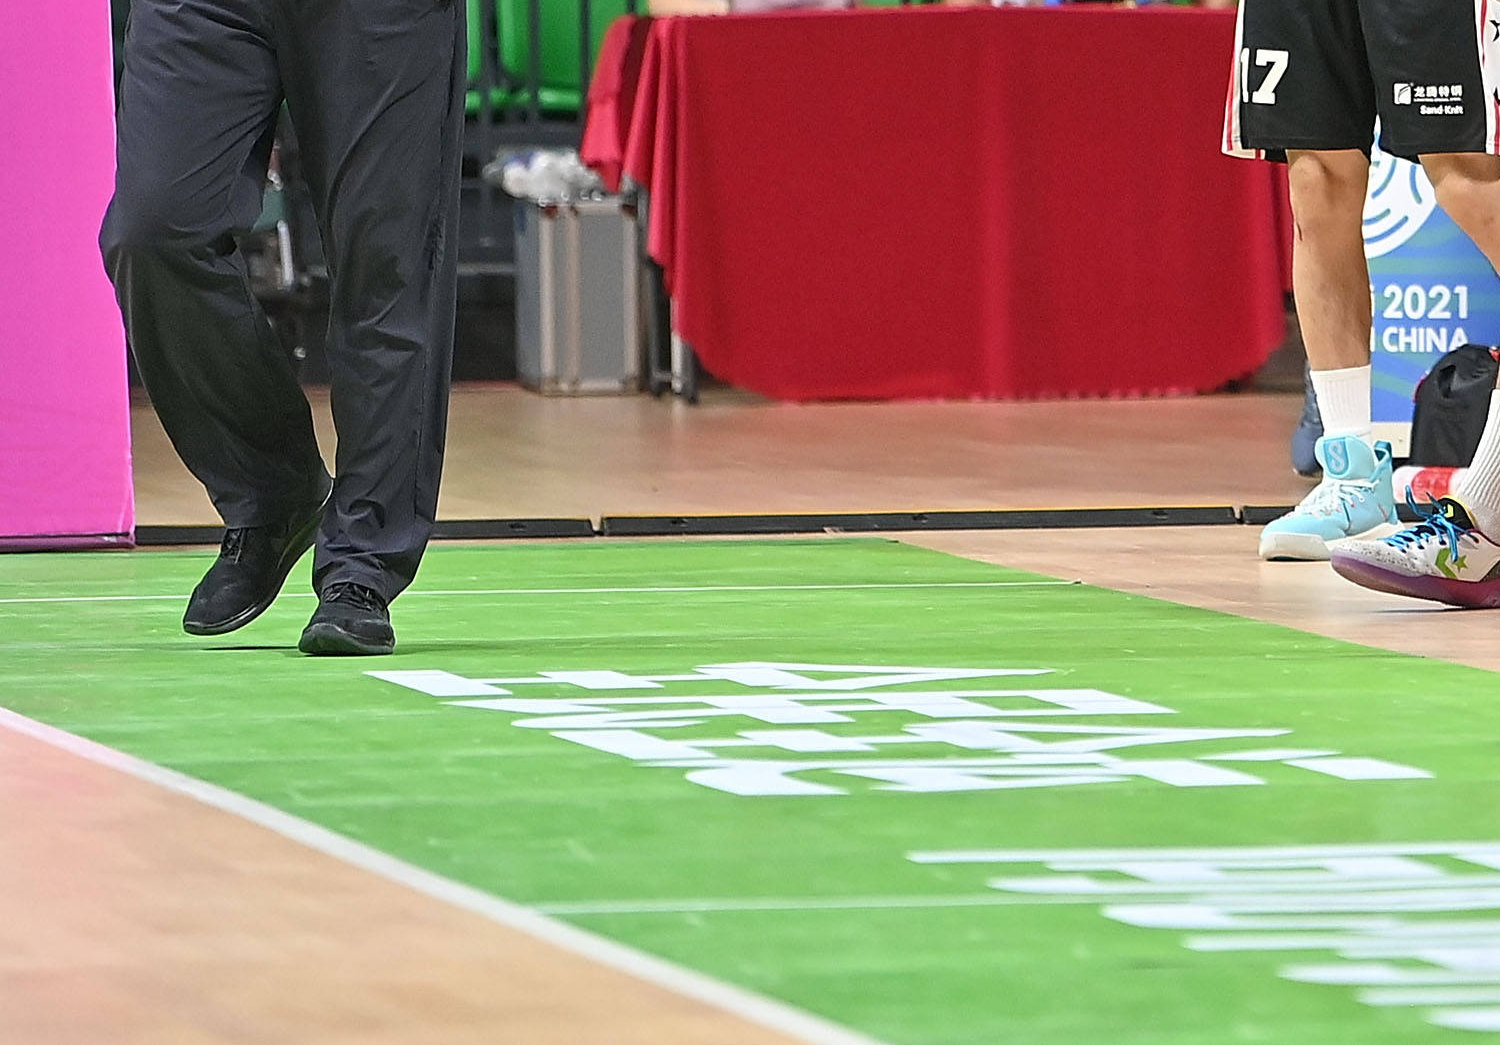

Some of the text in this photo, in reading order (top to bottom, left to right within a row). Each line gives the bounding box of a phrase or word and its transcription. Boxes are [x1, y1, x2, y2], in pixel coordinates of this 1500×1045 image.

[1240, 47, 1289, 104] 17
[1383, 284, 1468, 320] 2021
[1382, 326, 1468, 353] CHINA
